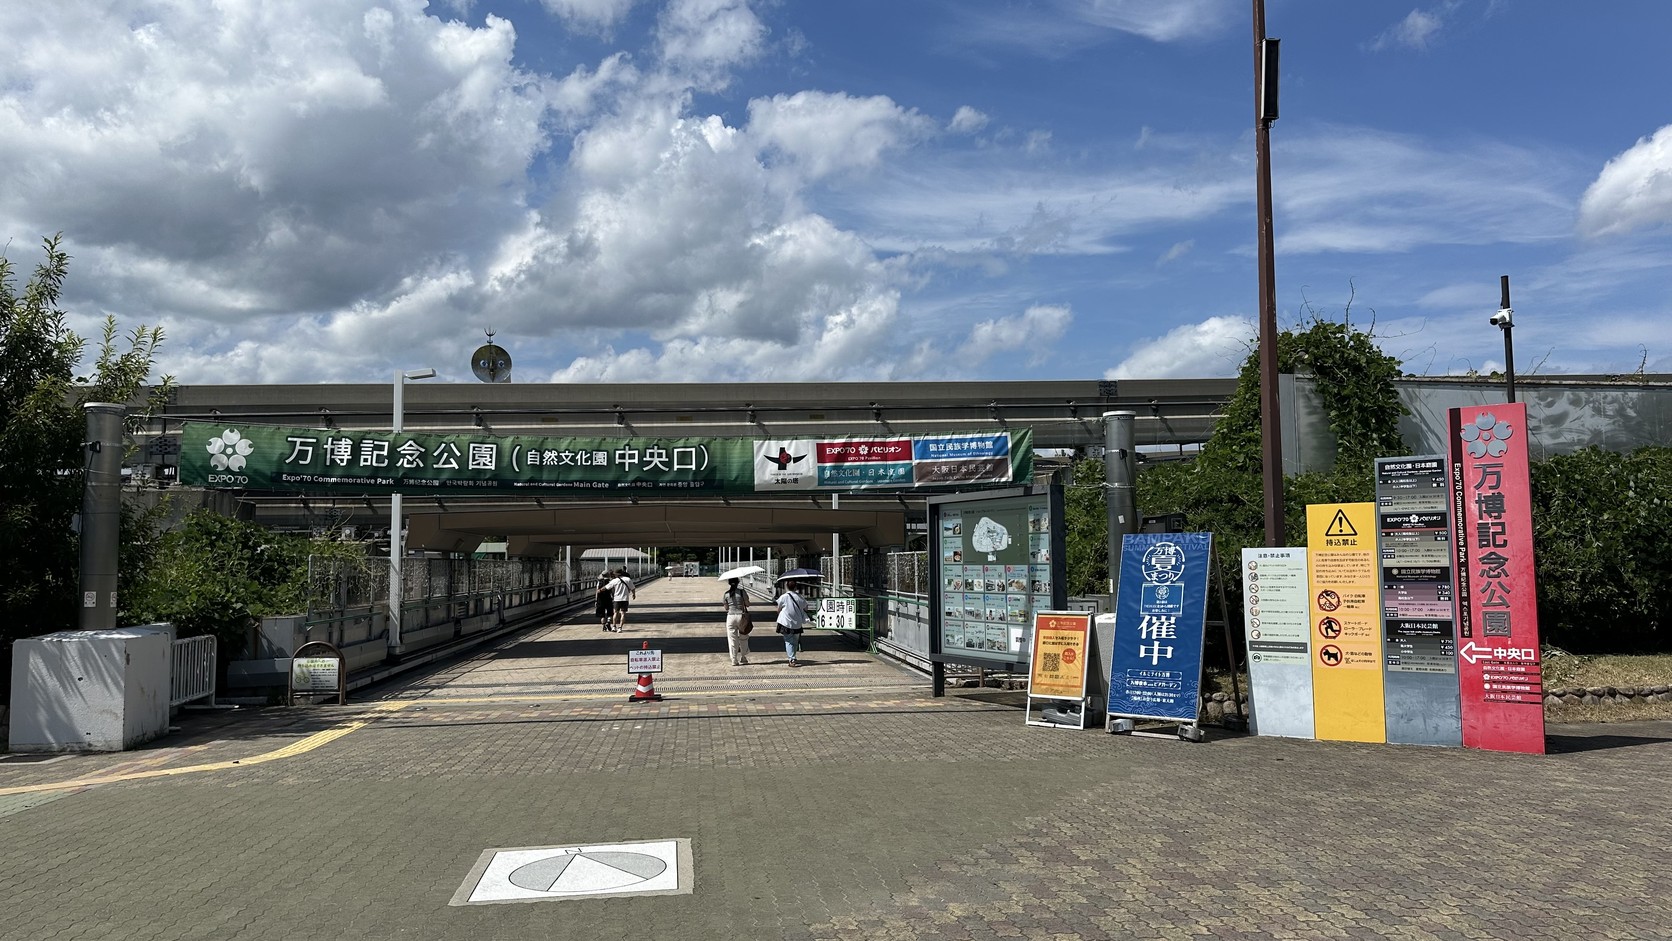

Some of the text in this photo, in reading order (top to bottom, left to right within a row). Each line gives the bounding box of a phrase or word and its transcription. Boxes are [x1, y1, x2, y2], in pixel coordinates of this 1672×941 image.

[285, 436, 498, 470] 万博記念公園
[929, 441, 994, 452] 国立民族学博物館
[931, 464, 994, 475] 大阪日本民芸館
[282, 474, 394, 485] Expo'70 Commemorative Park
[1454, 463, 1466, 563] Expo'70 Commemorative Park
[1154, 546, 1177, 555] 万博
[1474, 463, 1511, 637] 万博記念公園
[1151, 554, 1176, 571] 夏
[1151, 572, 1175, 581] まつり
[817, 600, 856, 613] 入園時間
[1493, 647, 1535, 660] 中央口
